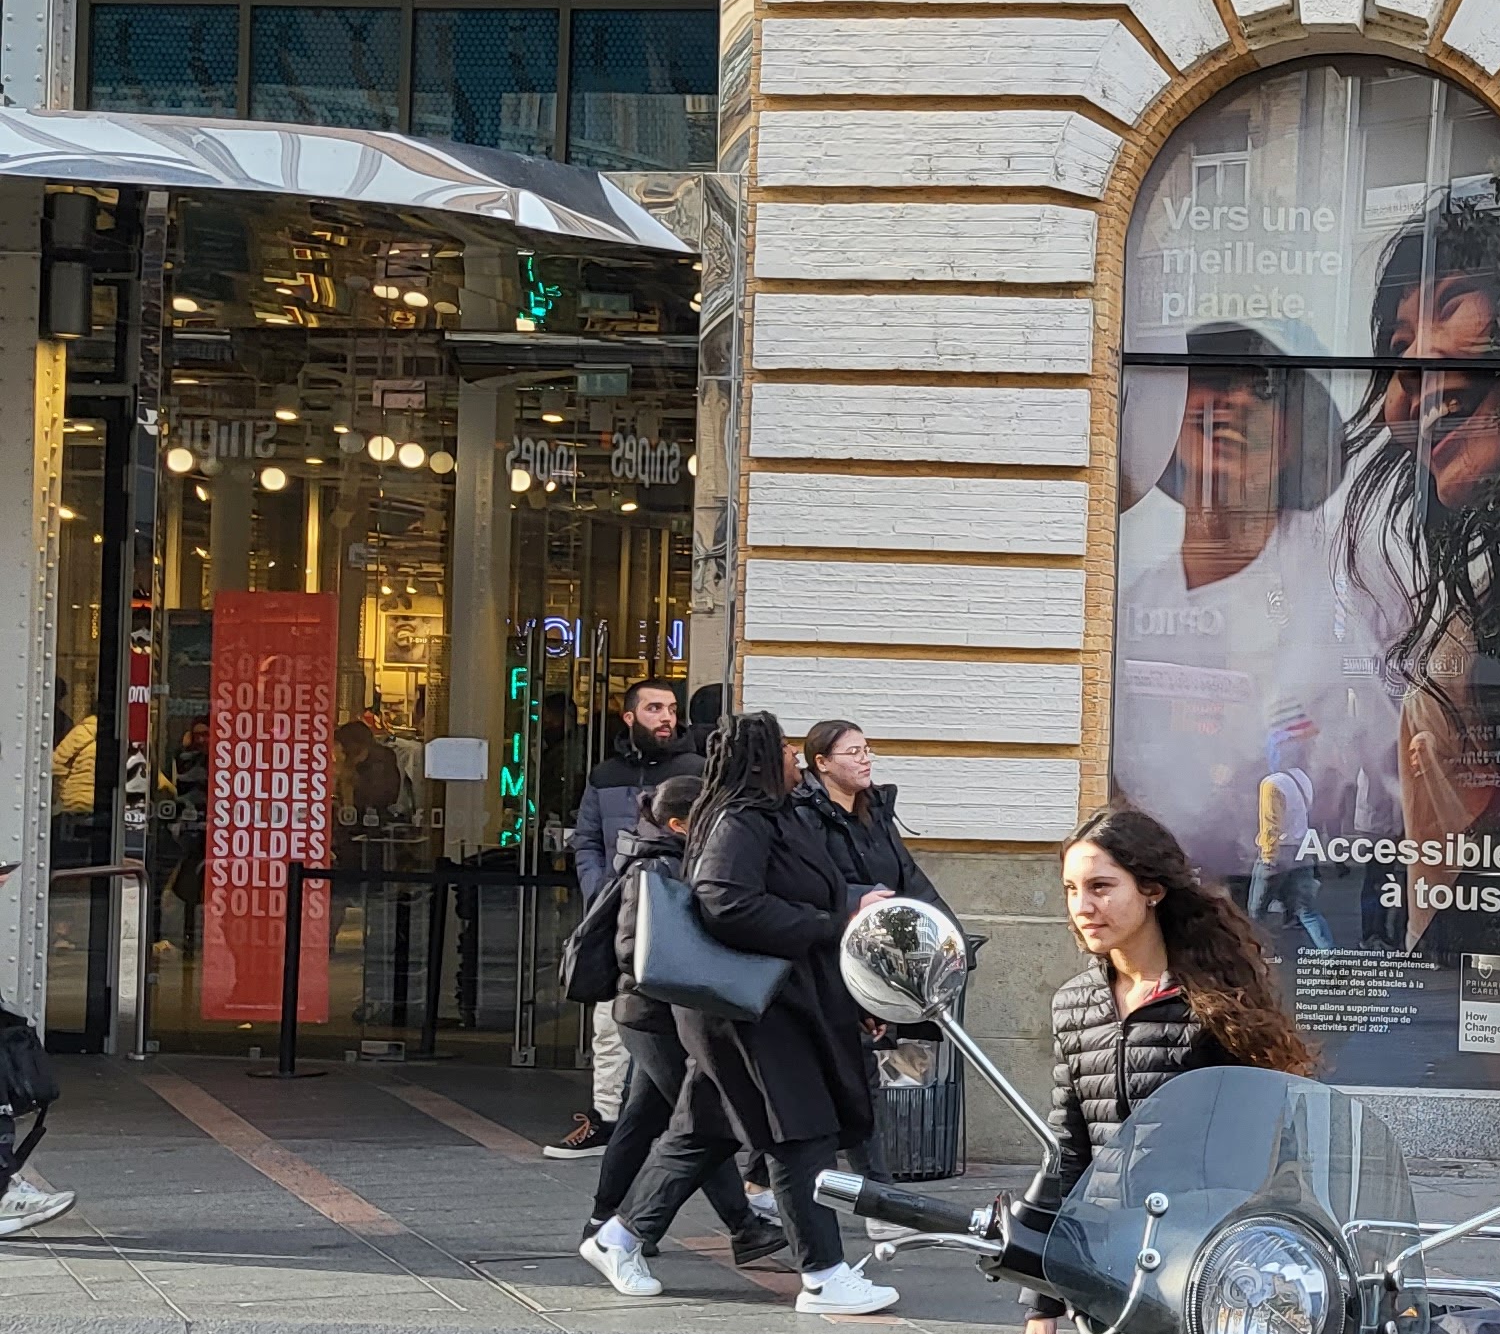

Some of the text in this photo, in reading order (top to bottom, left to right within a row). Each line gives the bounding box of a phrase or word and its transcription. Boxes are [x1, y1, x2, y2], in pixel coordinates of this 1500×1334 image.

[1163, 197, 1249, 232] Vers
[1262, 207, 1336, 234] une
[1162, 241, 1344, 276] meilleure
[1161, 282, 1315, 326] planète.
[217, 681, 330, 712] SOLDES
[215, 711, 328, 742] SOLDES
[214, 740, 327, 771] SOLDES
[213, 770, 327, 801] SOLDES
[213, 799, 326, 830] SOLDES
[212, 828, 325, 859] SOLDES
[211, 858, 325, 889] SOLDS
[210, 888, 324, 919] SOLDS
[1380, 874, 1403, 908] à
[1297, 957, 1361, 969] développement
[1362, 959, 1378, 967] des
[1411, 951, 1423, 959] au
[1296, 978, 1348, 989] suppression
[1349, 978, 1365, 988] des
[1366, 979, 1408, 989] obstacles
[1416, 980, 1424, 989] la
[1339, 969, 1350, 977] de
[1351, 968, 1378, 977] travail
[1296, 988, 1390, 999] progression d'ici 2030.
[1471, 987, 1499, 996] CARES
[1295, 1012, 1334, 1023] plastique
[1342, 1015, 1368, 1025] usage
[1369, 1015, 1399, 1025] unique
[1400, 1015, 1411, 1024] de
[1296, 1002, 1418, 1015] Nous allons supprimer tout le
[1465, 1011, 1488, 1021] How
[1312, 1022, 1348, 1032] activités
[1349, 1023, 1367, 1032] d'ici
[1368, 1023, 1391, 1034] 2027.
[1464, 1033, 1496, 1044] Looks
